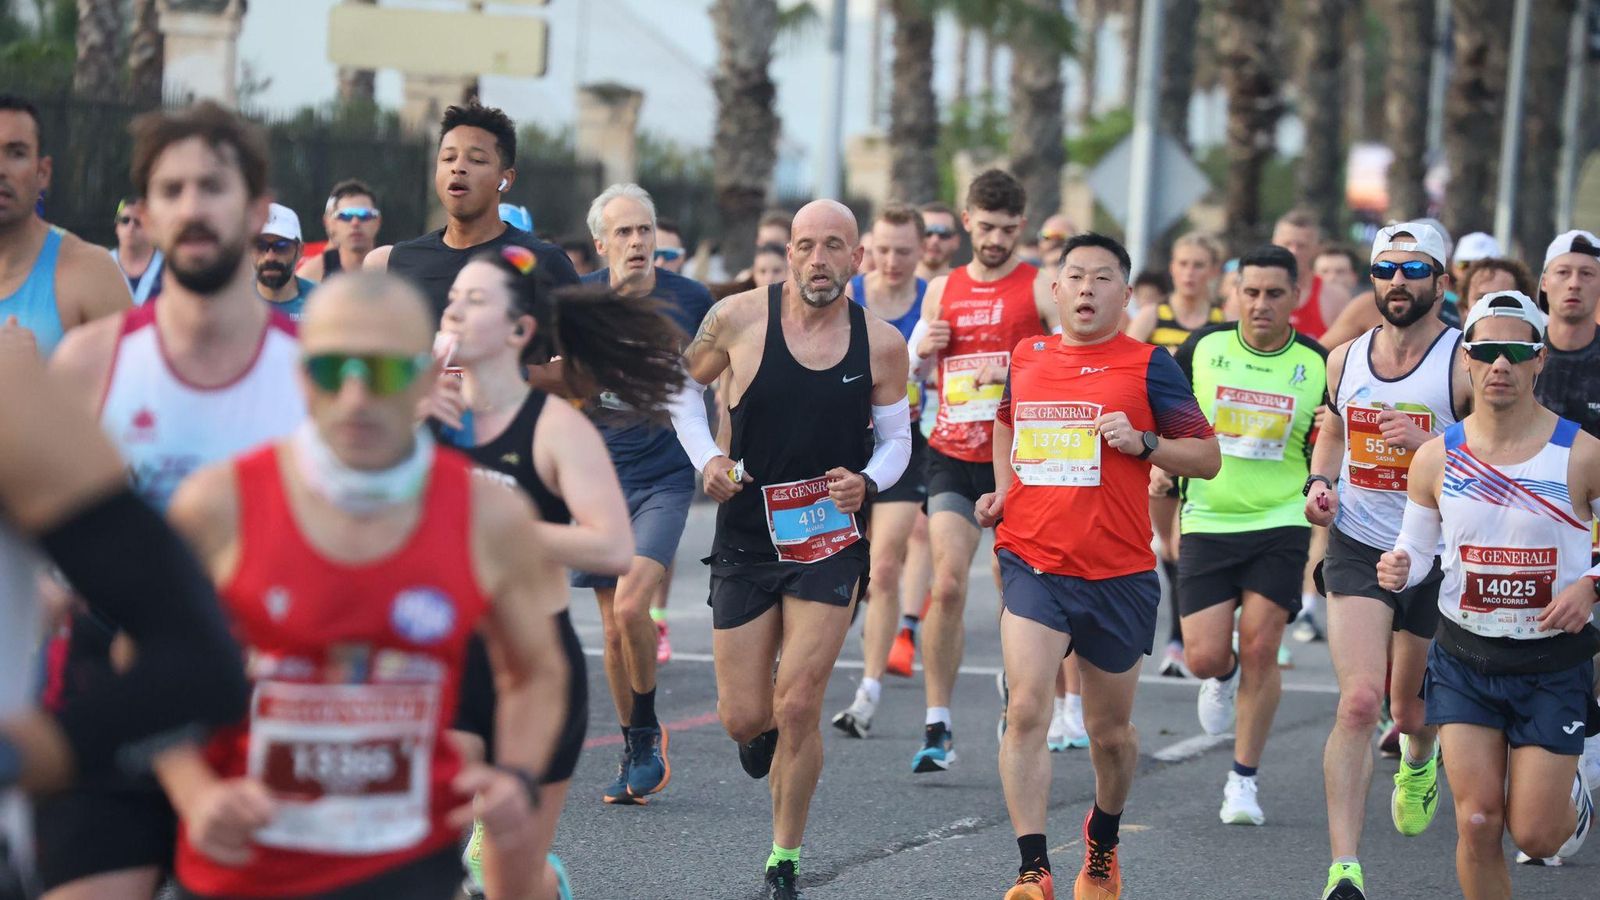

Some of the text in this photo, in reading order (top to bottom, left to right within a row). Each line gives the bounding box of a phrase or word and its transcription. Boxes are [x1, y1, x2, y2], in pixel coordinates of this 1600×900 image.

[1038, 407, 1093, 419] GENERALI
[1032, 432, 1081, 448] 13793
[789, 479, 836, 499] GENER
[799, 507, 826, 526] 419
[1482, 550, 1551, 564] GENERALI
[1477, 578, 1536, 597] 14025
